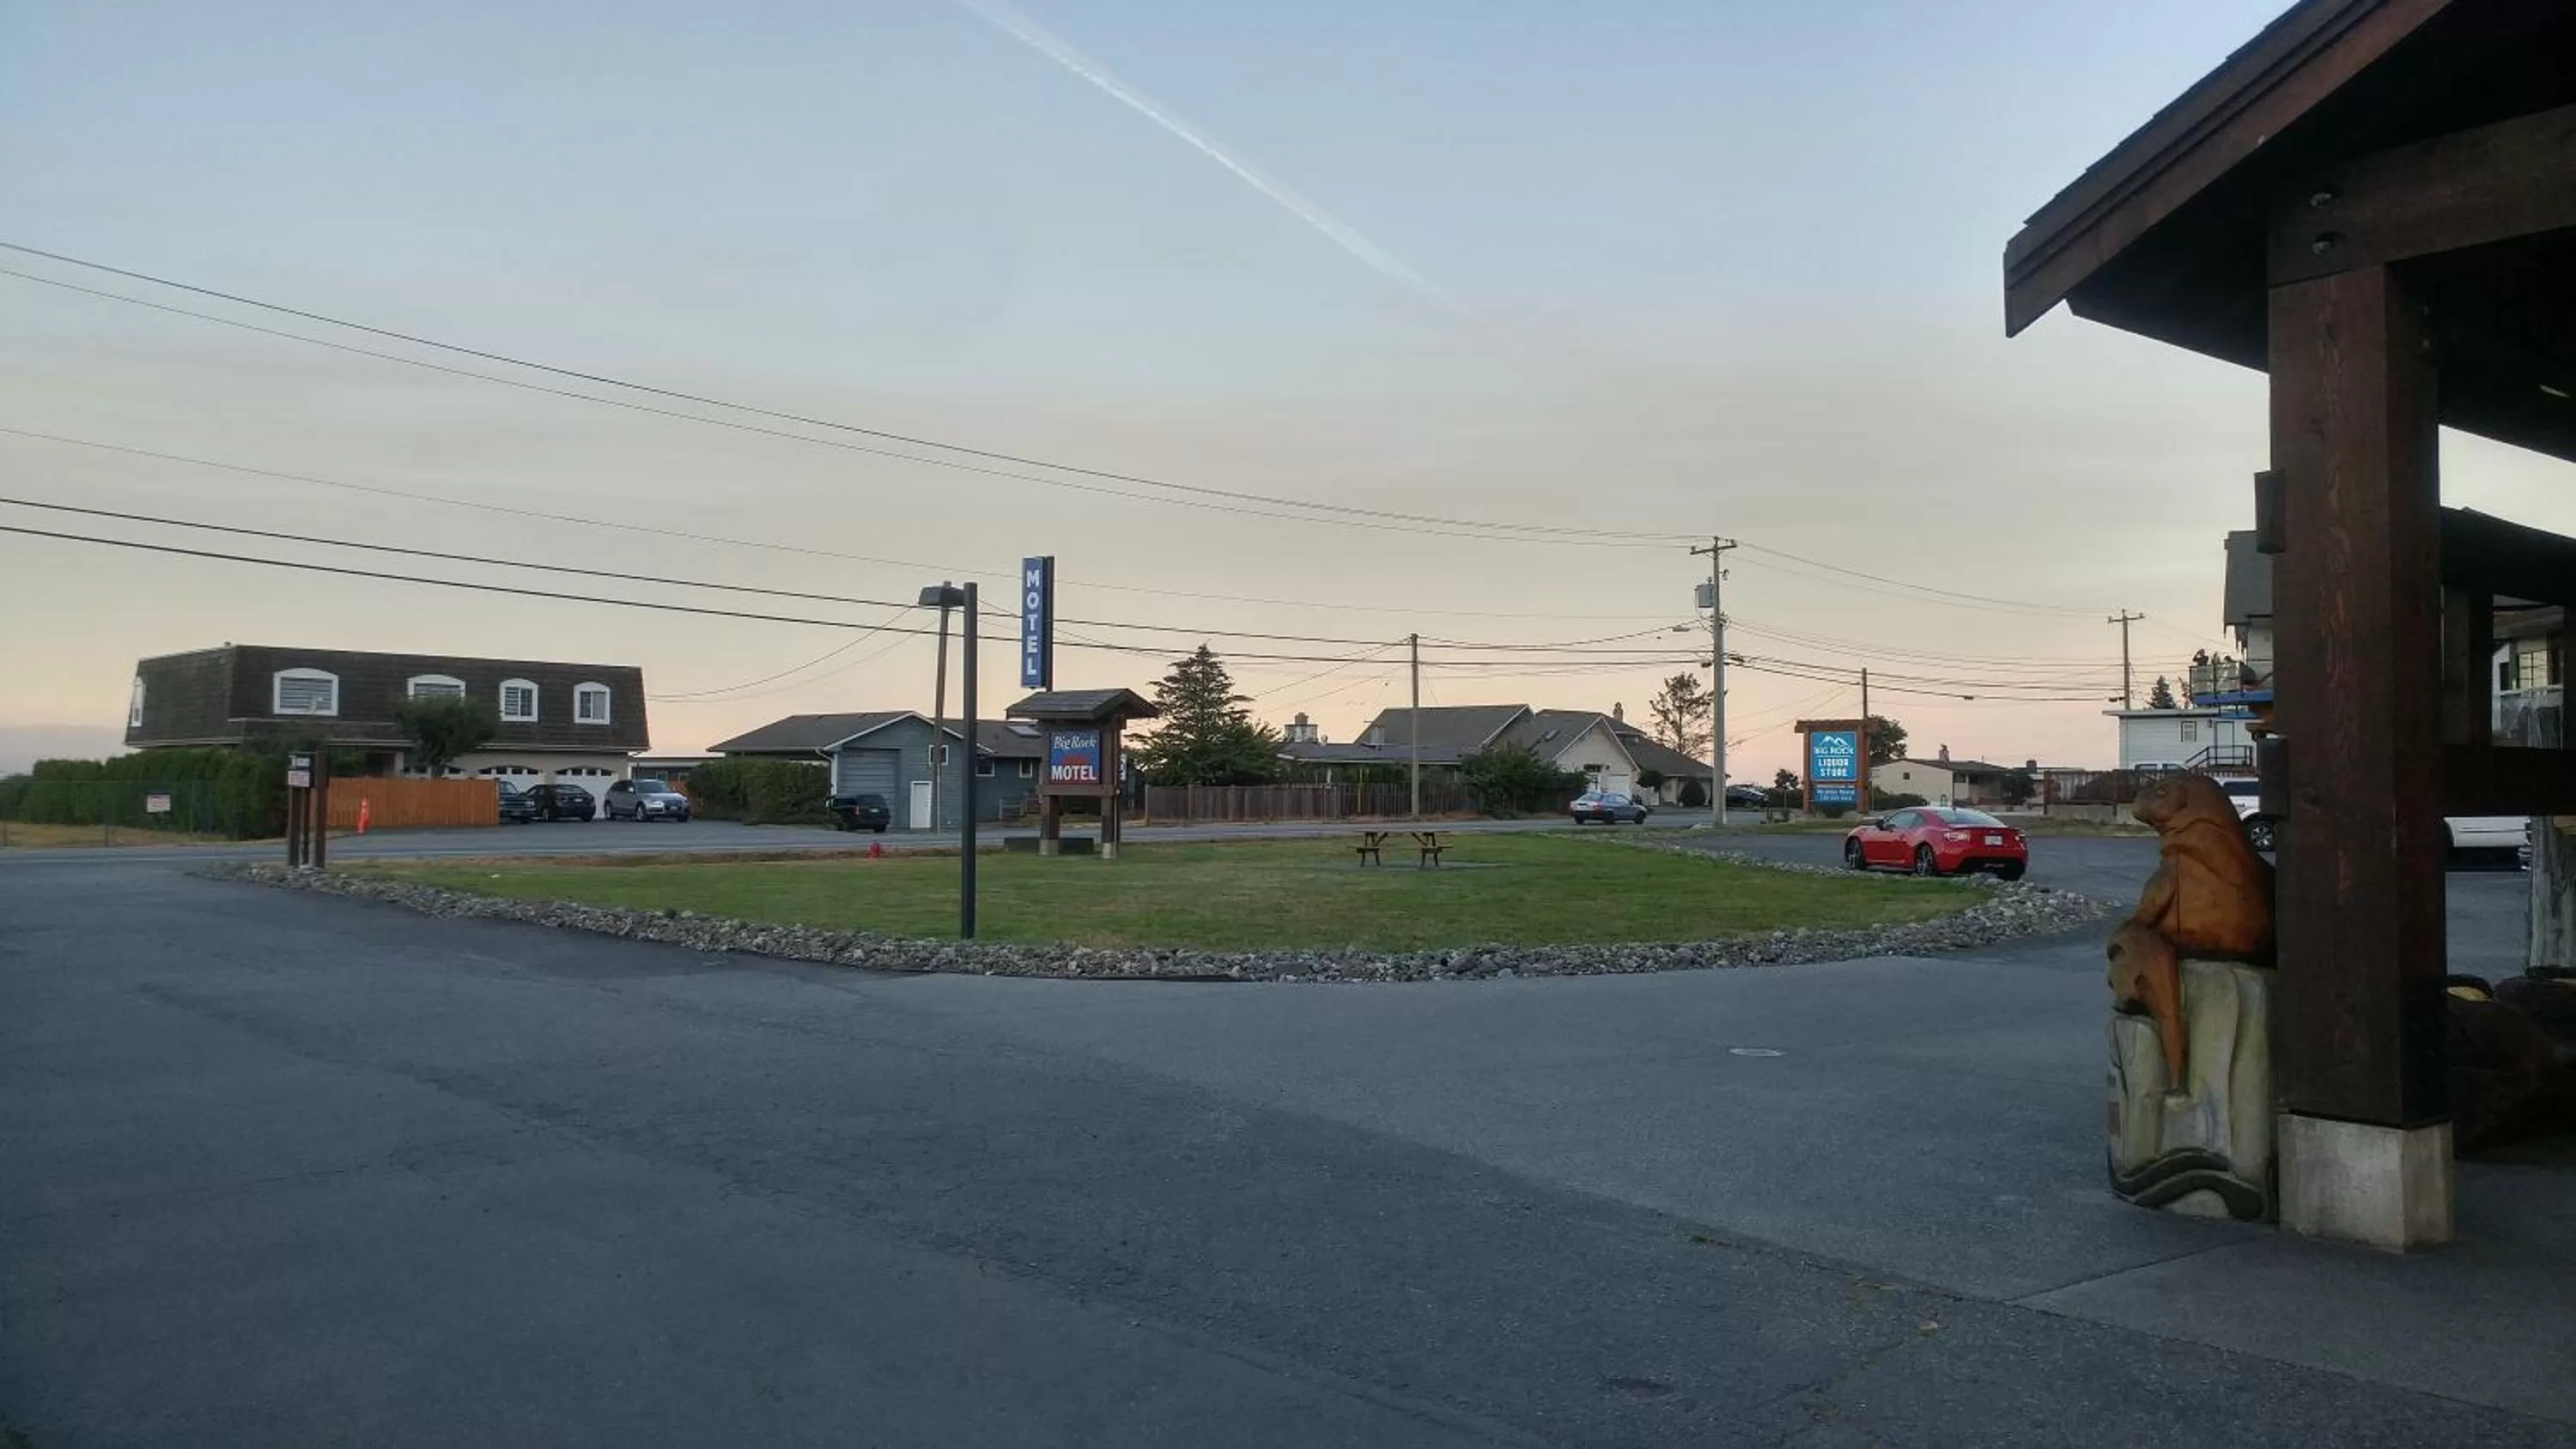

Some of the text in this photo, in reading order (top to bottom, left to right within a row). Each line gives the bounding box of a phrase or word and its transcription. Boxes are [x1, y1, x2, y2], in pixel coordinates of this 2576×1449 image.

[1026, 569, 1040, 676] MOTEL
[1830, 746, 1854, 755] ROCK
[1818, 758, 1849, 767] LIQUOR
[1051, 765, 1097, 780] MOTEL
[1820, 768, 1848, 777] STORE
